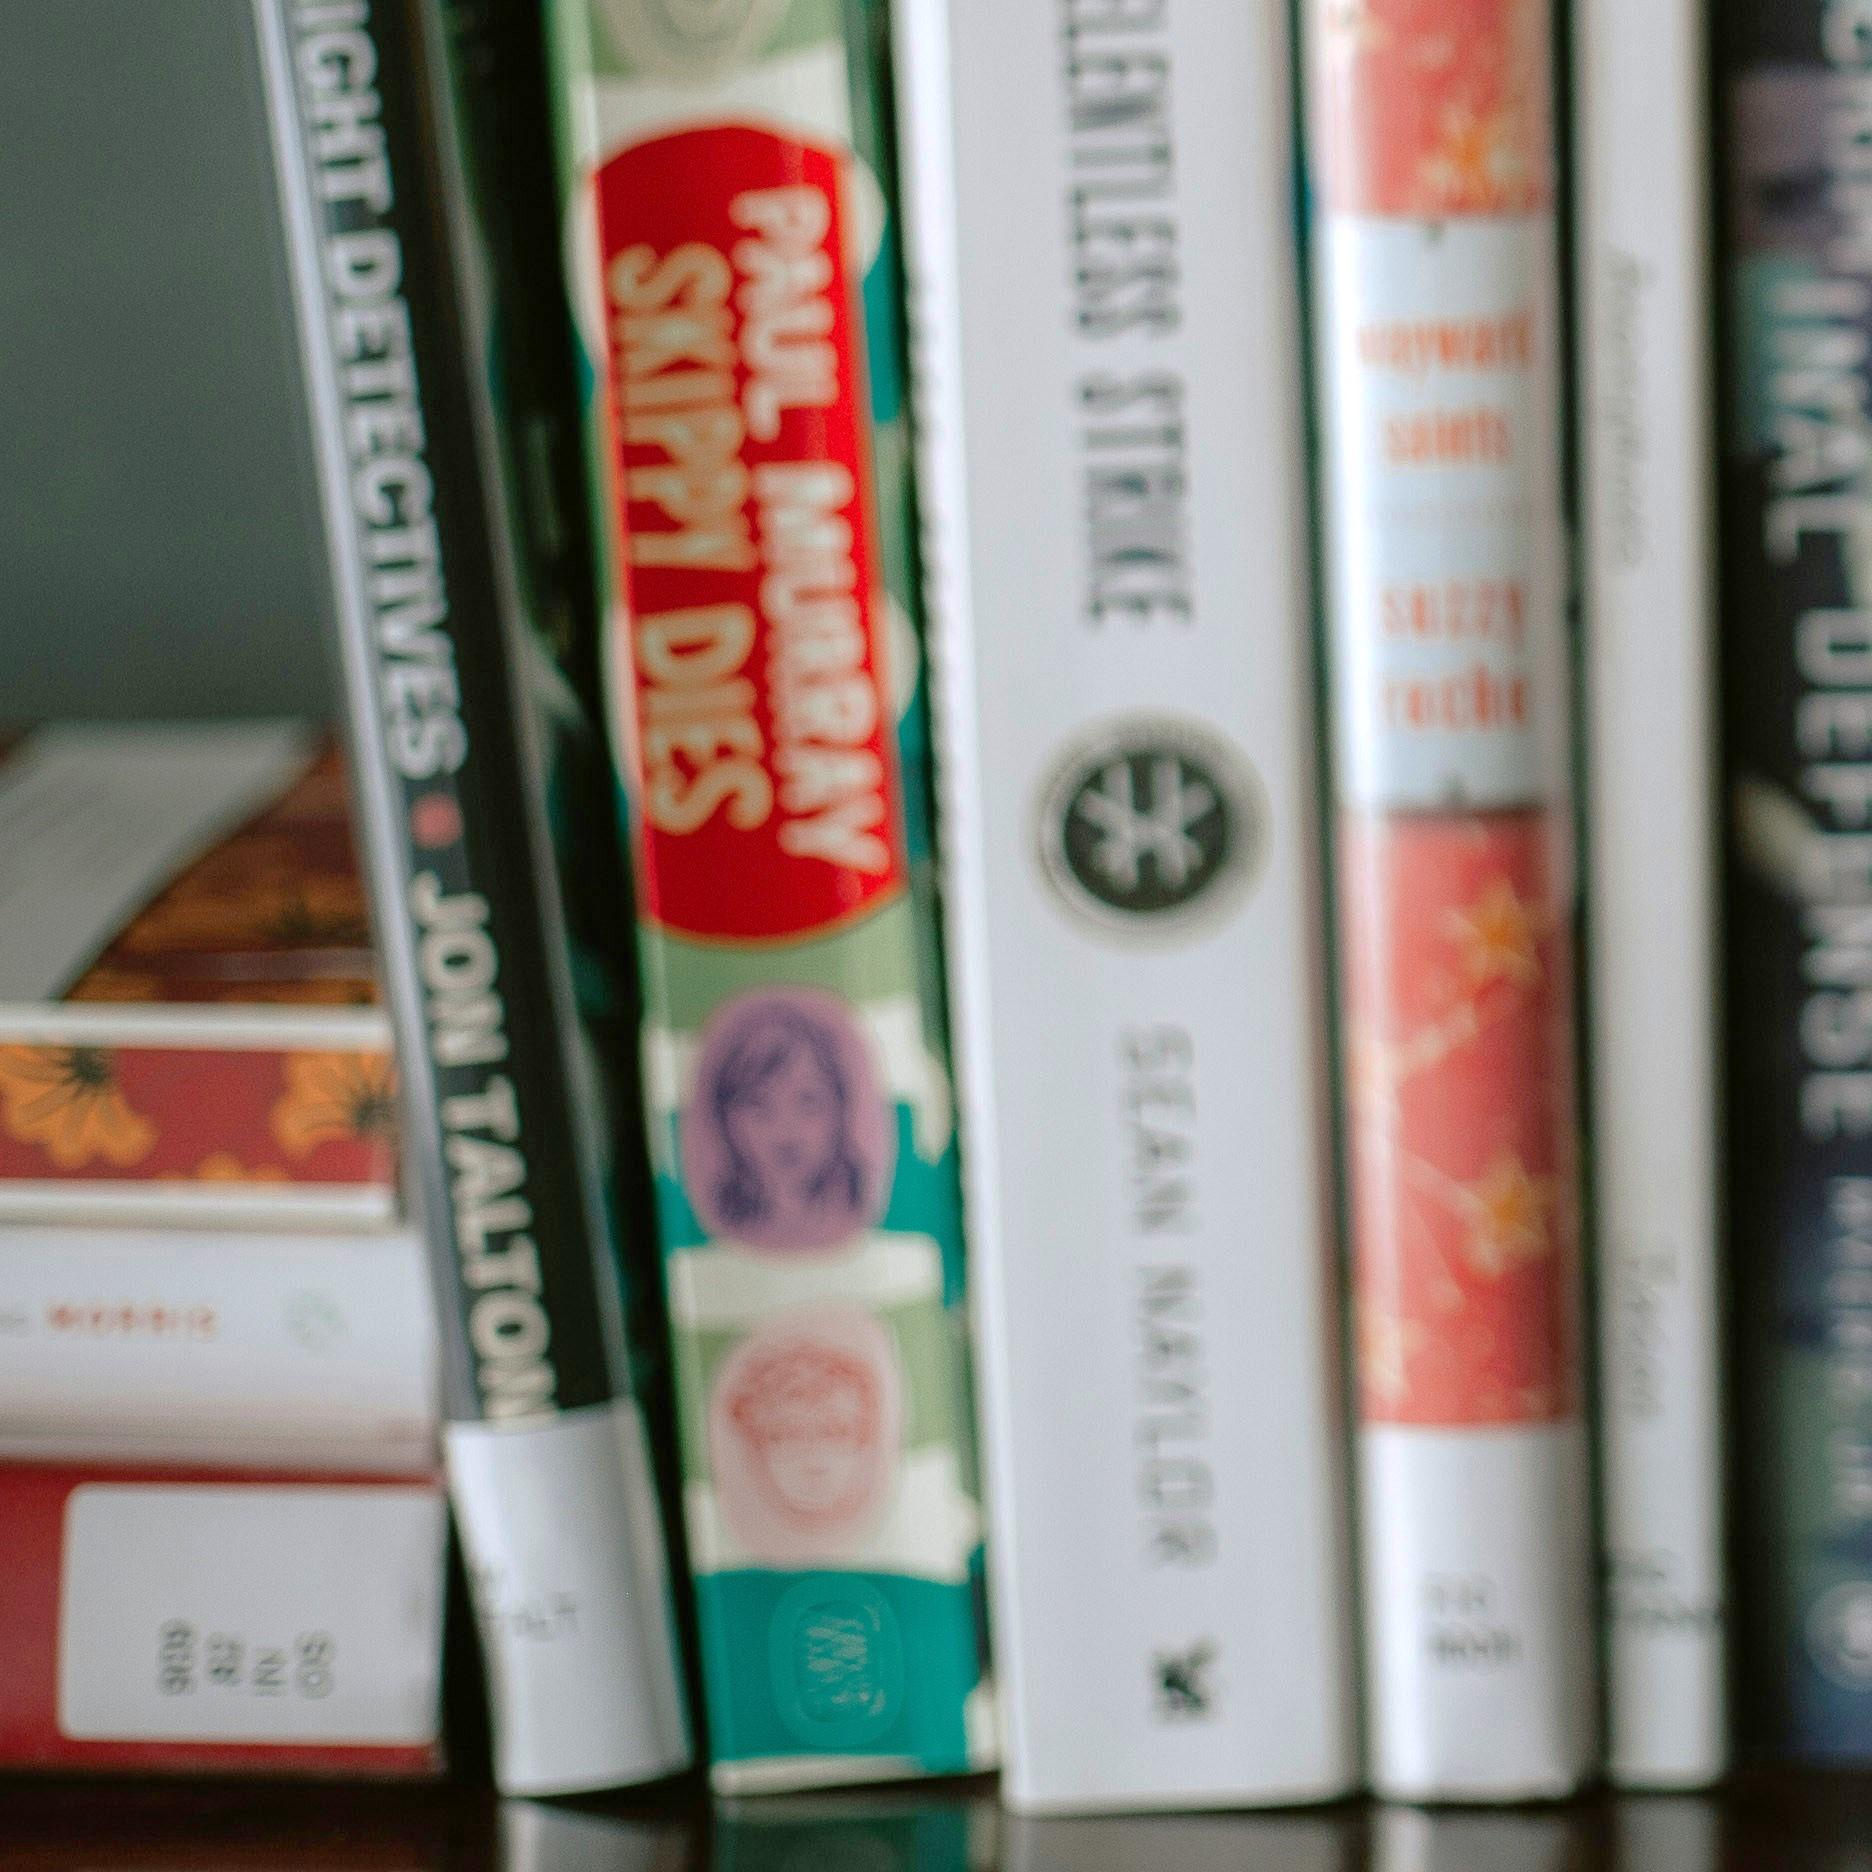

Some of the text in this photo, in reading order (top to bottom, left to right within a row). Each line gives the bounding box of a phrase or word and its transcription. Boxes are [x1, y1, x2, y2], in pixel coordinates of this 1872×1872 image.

[321, 226, 468, 780] DETECTIVES
[608, 240, 775, 837] SKIPPY DIES
[726, 181, 892, 877] PAUL MURRAY
[1078, 368, 1198, 630] STRIKE
[413, 869, 511, 1069] JON
[444, 1074, 560, 1427] TALTON
[1114, 1022, 1219, 1575] SEAN NAYLOR
